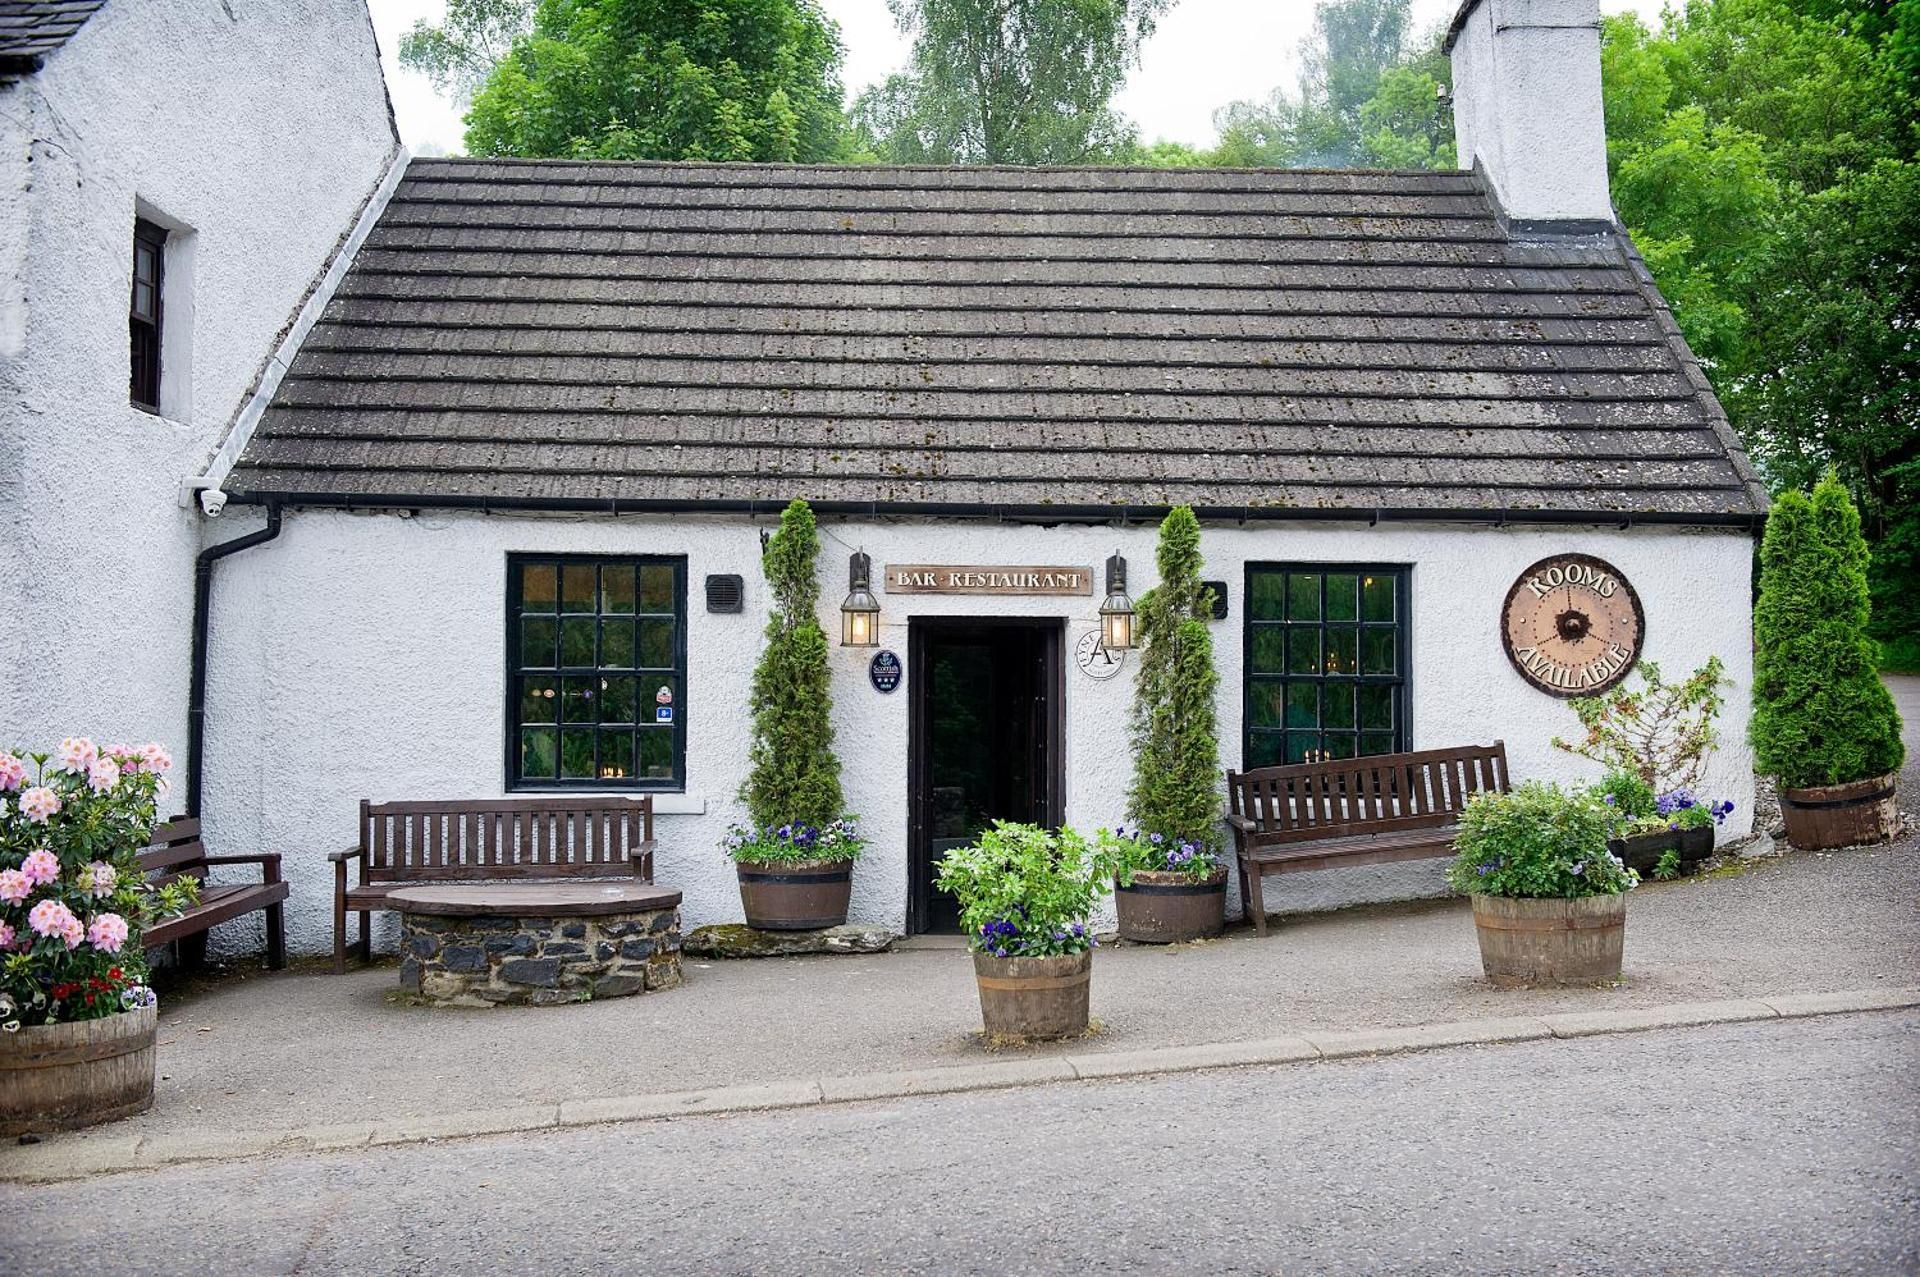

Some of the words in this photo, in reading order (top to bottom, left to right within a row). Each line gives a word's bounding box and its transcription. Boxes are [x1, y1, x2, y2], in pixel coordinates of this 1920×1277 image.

[897, 572, 937, 587] BAR
[949, 573, 1081, 588] RESTAURANT
[1526, 563, 1618, 599] ROOMS
[1516, 642, 1631, 689] AVAILABLE
